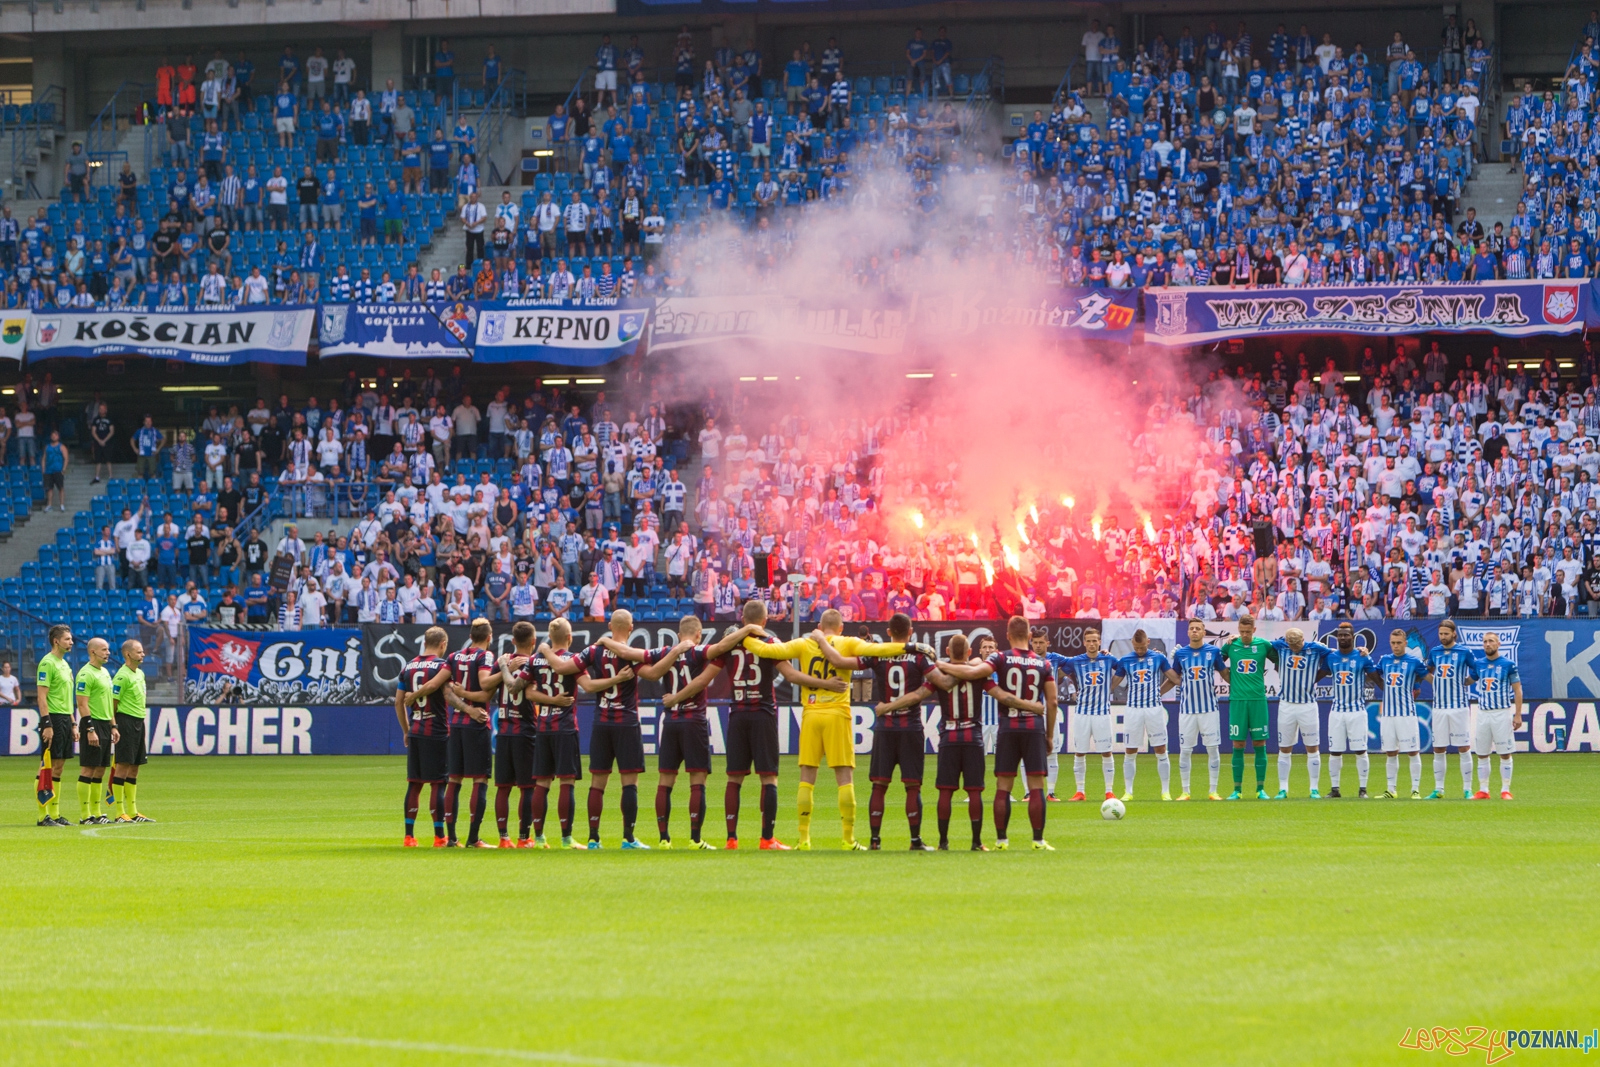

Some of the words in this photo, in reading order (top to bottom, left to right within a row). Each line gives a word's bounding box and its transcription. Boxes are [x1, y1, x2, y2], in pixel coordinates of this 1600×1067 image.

[356, 304, 436, 315] MUROWANA
[364, 315, 425, 326] GOŚLINA
[73, 316, 257, 346] KOŚCIAN
[512, 316, 610, 345] KĘPNO
[1053, 626, 1098, 649] 198
[405, 660, 439, 672] MURAWSKI
[731, 649, 762, 687] 23
[1006, 655, 1044, 668] ZWOLIŃSKI
[1236, 659, 1258, 674] STS
[1286, 655, 1307, 670] STS
[1085, 672, 1104, 686] STS
[1133, 669, 1152, 683] STS
[1188, 666, 1207, 681] STS
[1335, 672, 1354, 686] STS
[1437, 665, 1455, 679] STS
[458, 664, 469, 700] 7
[888, 665, 905, 702] 9
[1005, 667, 1040, 704] 93
[1386, 673, 1404, 687] STS
[1481, 677, 1499, 692] STS
[412, 671, 427, 708] 6
[948, 681, 974, 719] 11
[9, 707, 313, 755] BACHER
[1229, 724, 1239, 736] 30
